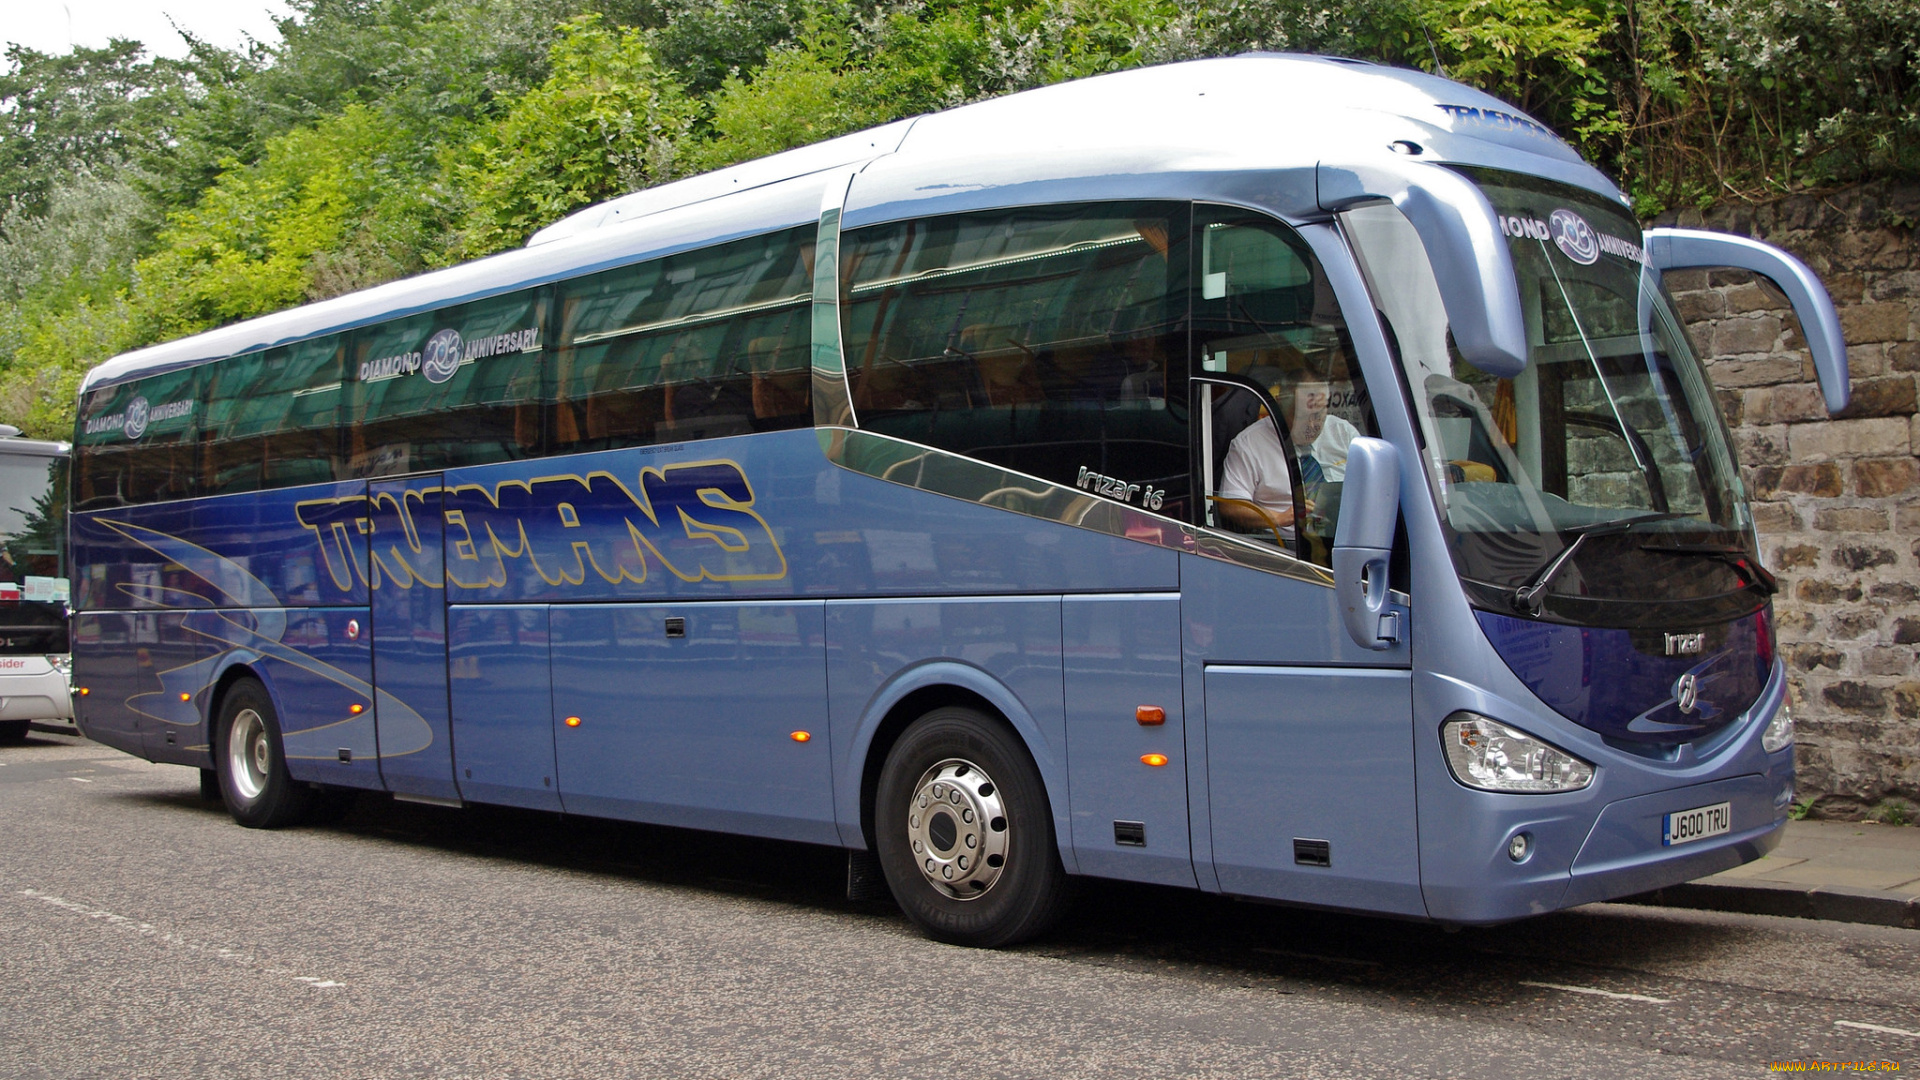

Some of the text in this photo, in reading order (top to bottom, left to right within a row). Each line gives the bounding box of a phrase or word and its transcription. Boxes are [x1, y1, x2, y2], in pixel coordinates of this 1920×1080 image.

[1499, 215, 1550, 241] MOND
[360, 351, 421, 381] DIAMOND
[463, 328, 538, 360] ANNIVERSARY
[86, 413, 125, 435] DIAMOND
[149, 399, 194, 422] ANNIVERSARY
[1076, 465, 1165, 511] Irizar i6
[296, 459, 788, 592] TRUEMANS
[1672, 806, 1728, 840] J600 TRU
